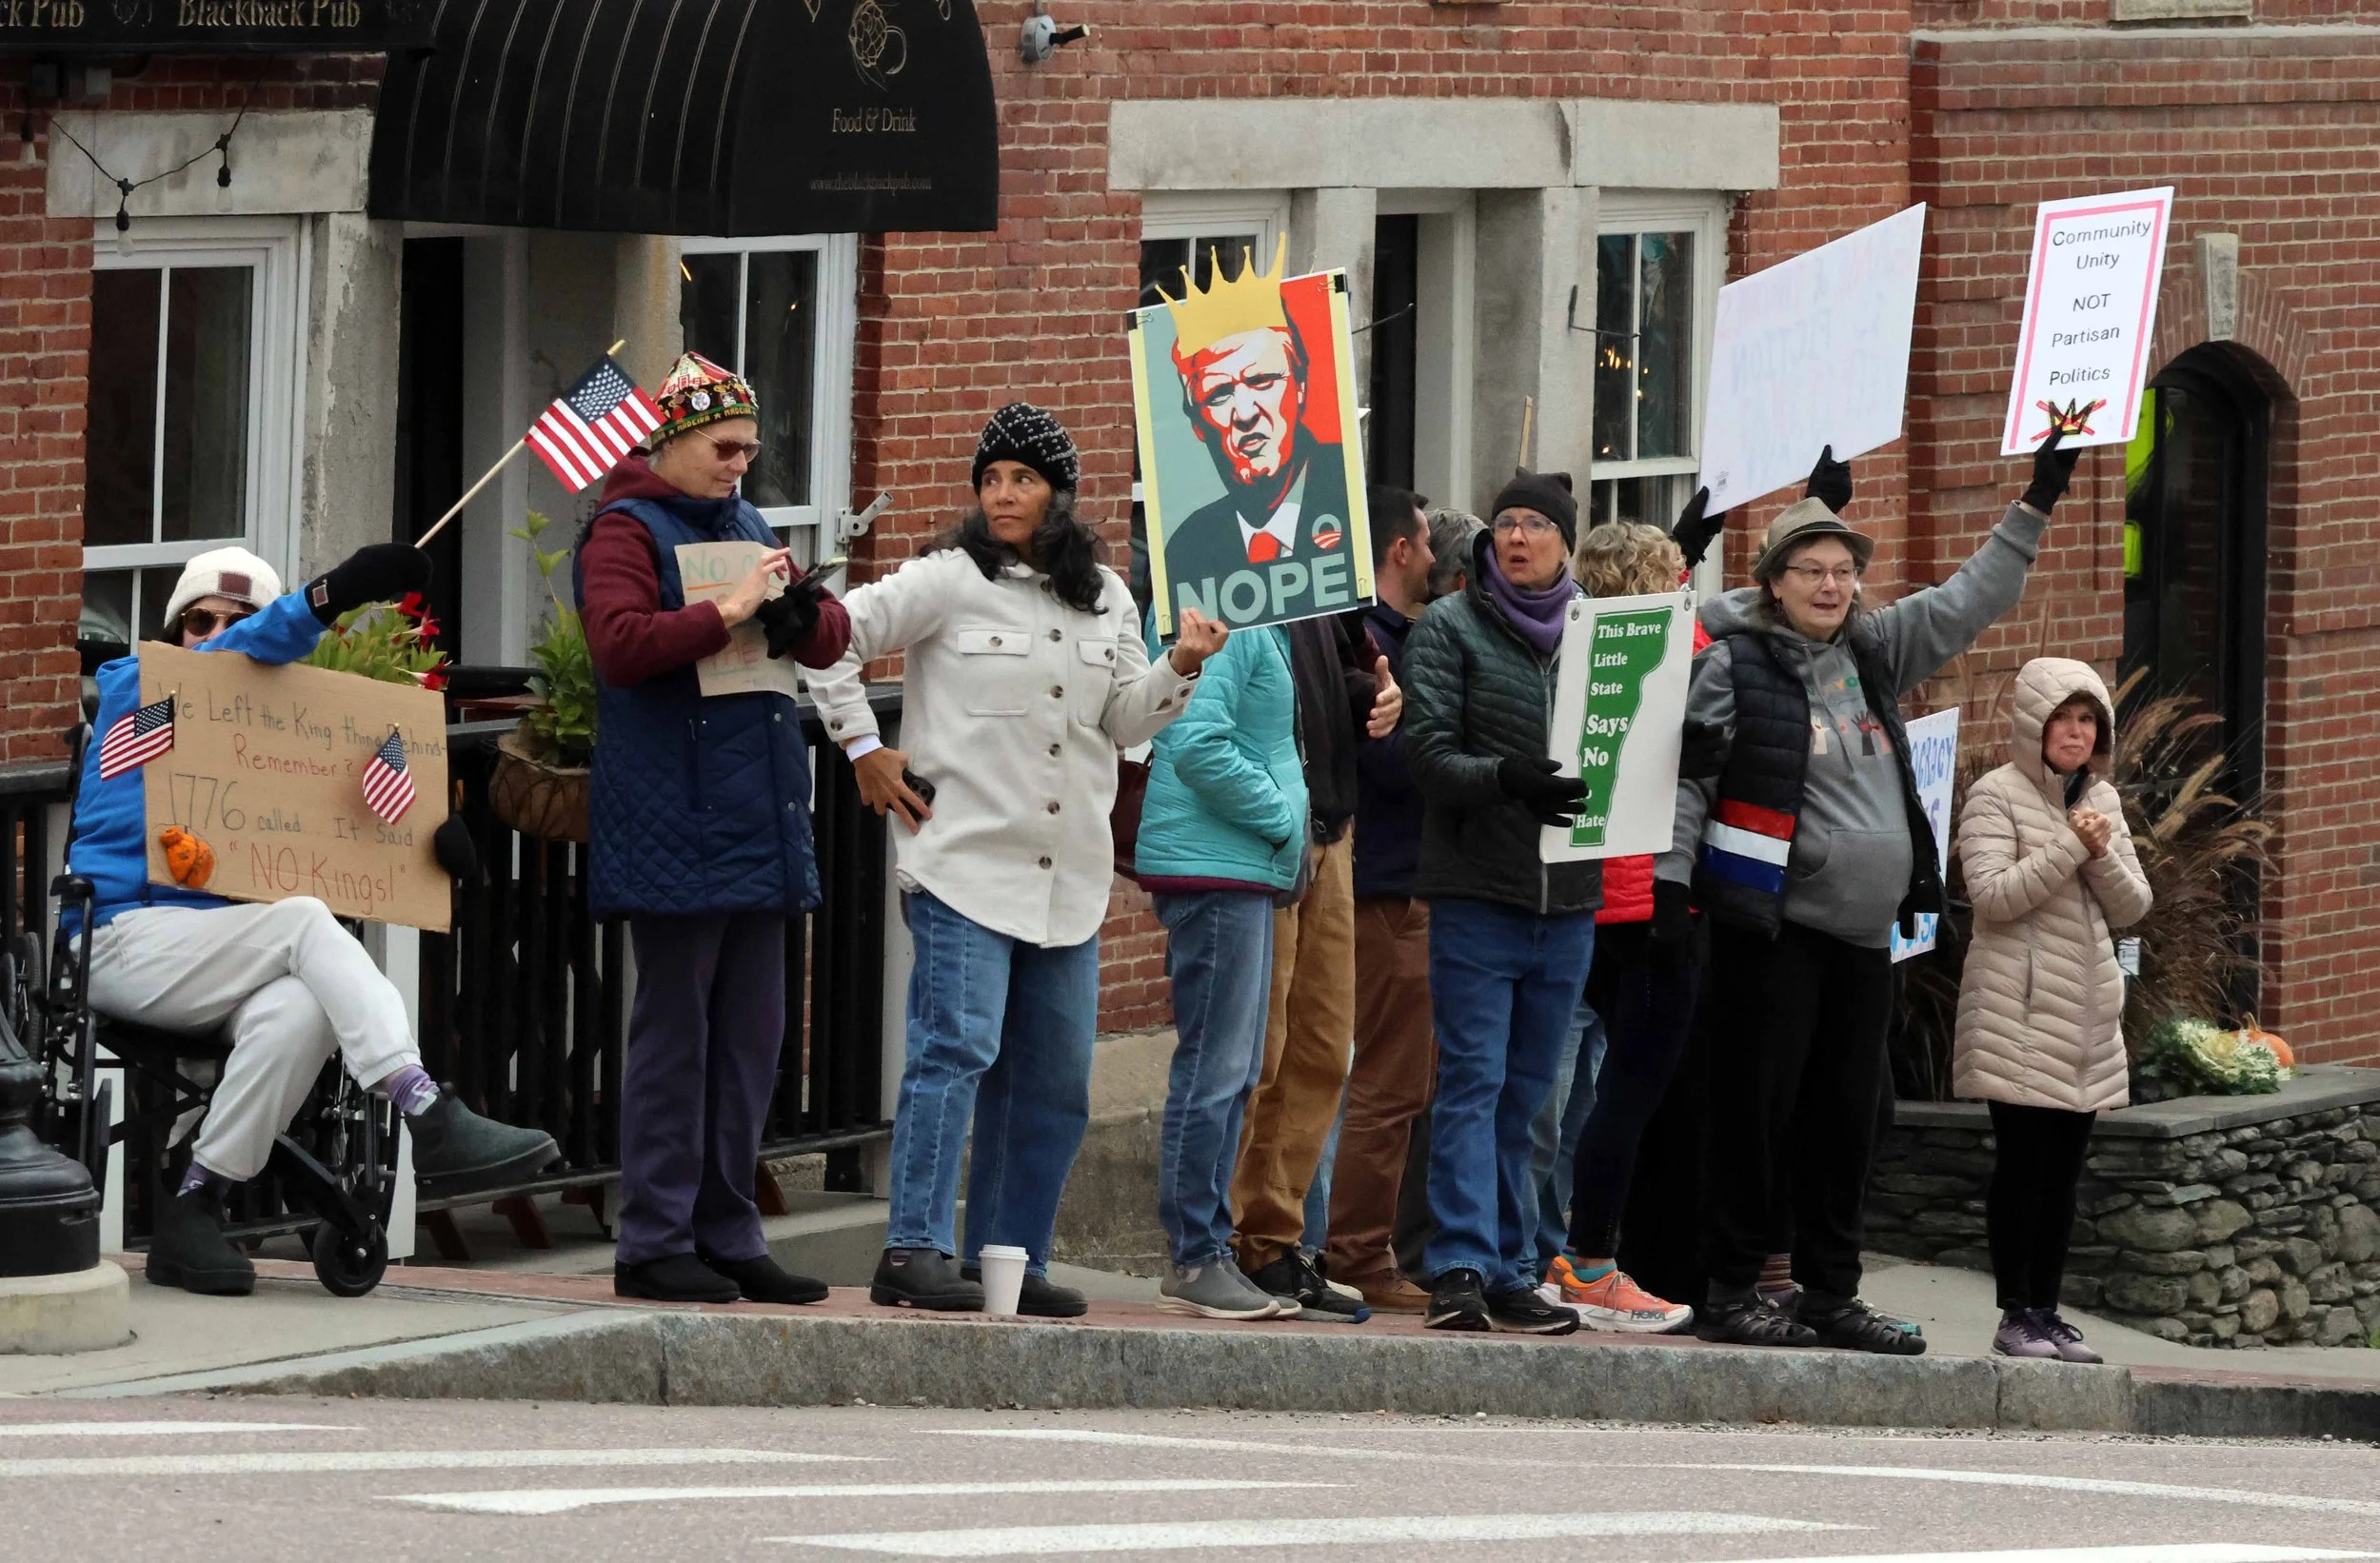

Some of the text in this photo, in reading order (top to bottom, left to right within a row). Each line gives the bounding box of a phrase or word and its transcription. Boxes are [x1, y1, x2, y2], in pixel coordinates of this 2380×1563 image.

[30, 0, 85, 27] Pub
[178, 0, 361, 27] Blackback Pub
[832, 107, 917, 133] Food & Drink
[2053, 220, 2152, 247] Community
[2076, 252, 2120, 269] Unity
[2073, 293, 2112, 312] NOT
[2052, 326, 2120, 347] Partisan
[2050, 366, 2111, 386] Politics
[684, 549, 728, 583] NO
[1177, 552, 1350, 623] NOPE
[1597, 623, 1661, 639] This Brave
[1594, 652, 1628, 667] Little
[1591, 683, 1623, 696] State
[208, 685, 252, 726] Left
[259, 703, 286, 731] the
[291, 702, 332, 751] King
[1586, 714, 1628, 737] Says
[1582, 747, 1609, 767] No
[1911, 734, 1955, 790] OCRACY
[169, 772, 246, 831] 1776
[335, 818, 360, 841] It
[374, 822, 413, 846] Said
[1576, 814, 1605, 828] Hate
